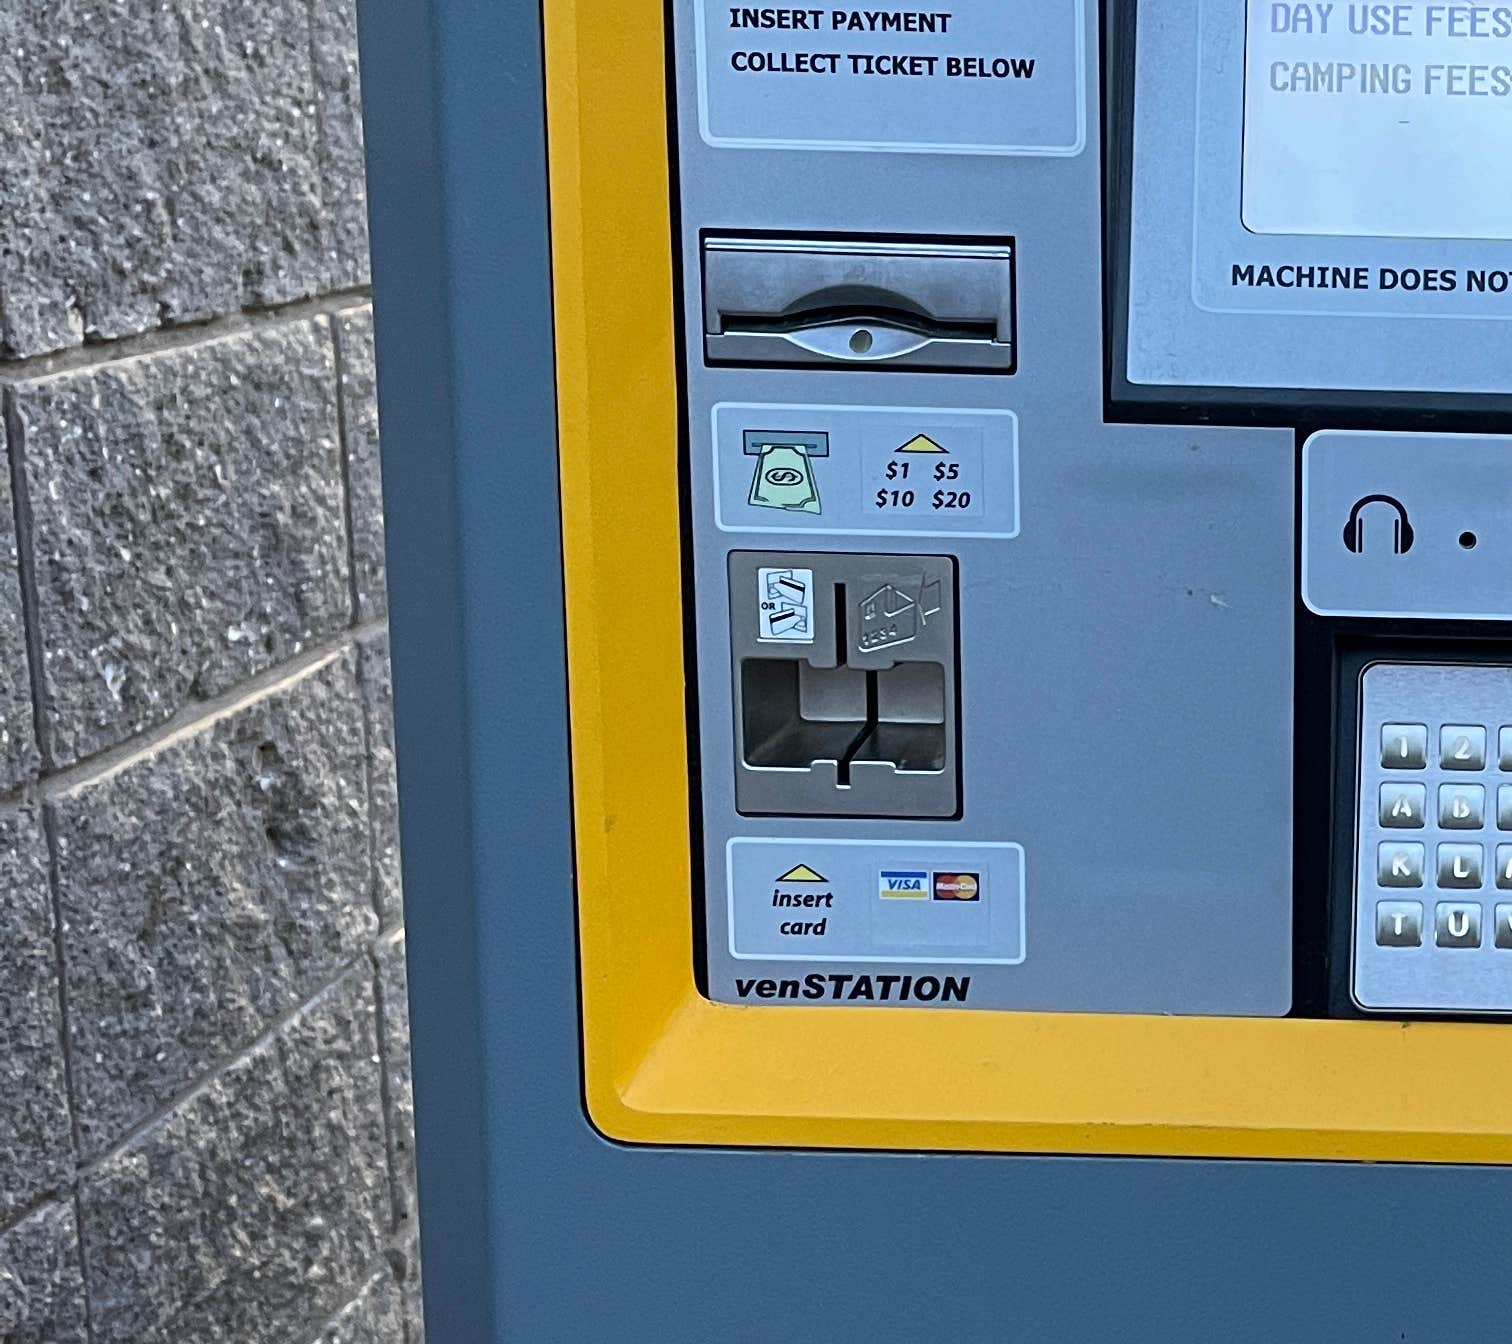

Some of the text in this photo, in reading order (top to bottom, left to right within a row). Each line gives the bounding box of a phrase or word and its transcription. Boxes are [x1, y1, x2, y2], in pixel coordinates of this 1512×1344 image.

[729, 7, 953, 34] INSERT PAYMENT
[1270, 2, 1512, 39] DAY USE FEES
[731, 51, 1036, 79] COLLECT TICKET BELOW
[1268, 60, 1512, 97] CAMPING FEES
[1231, 264, 1369, 290] MACHINE
[1379, 267, 1457, 292] DOES
[885, 460, 960, 482] $1 $5
[875, 487, 971, 510] $10 $20
[760, 601, 776, 611] OR
[1455, 736, 1471, 760] 2
[1392, 795, 1412, 817] A
[1453, 795, 1470, 818] B
[1392, 853, 1411, 876] K
[1453, 856, 1469, 878] L
[887, 878, 922, 890] VISA
[772, 888, 834, 908] insert
[780, 917, 827, 936] card
[1392, 912, 1407, 935] T
[1448, 911, 1469, 936] U
[735, 973, 971, 1002] venSTATION
